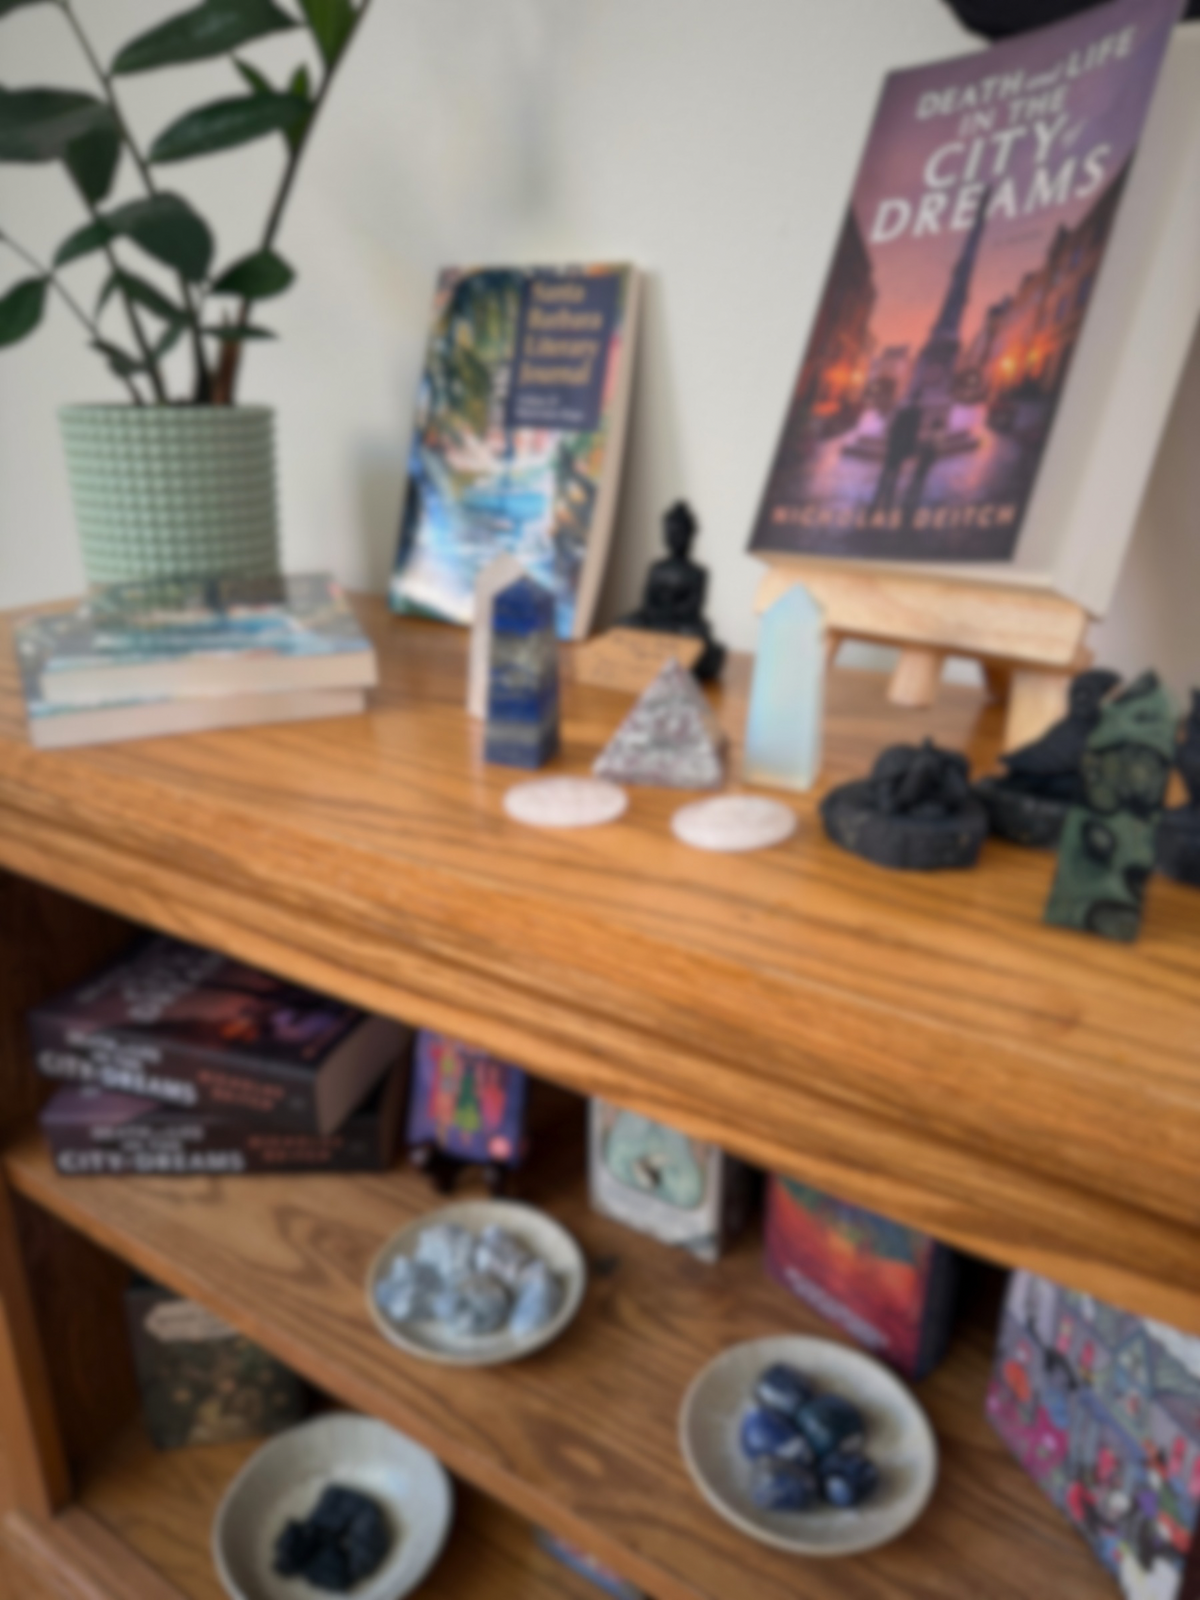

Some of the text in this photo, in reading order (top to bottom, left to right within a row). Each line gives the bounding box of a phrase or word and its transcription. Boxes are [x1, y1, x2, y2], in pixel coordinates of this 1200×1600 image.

[916, 69, 1025, 119] DEATH
[1065, 26, 1137, 78] LIFE
[959, 85, 1069, 138] IN THE
[923, 114, 1067, 189] CITY
[871, 143, 1111, 244] DREAMS
[771, 503, 1017, 531] NICHOLAS DEITCH
[38, 1050, 93, 1080] CITY
[101, 1065, 198, 1106] DREAMS
[57, 1149, 123, 1172] CITY
[134, 1149, 246, 1173] DREAMS
